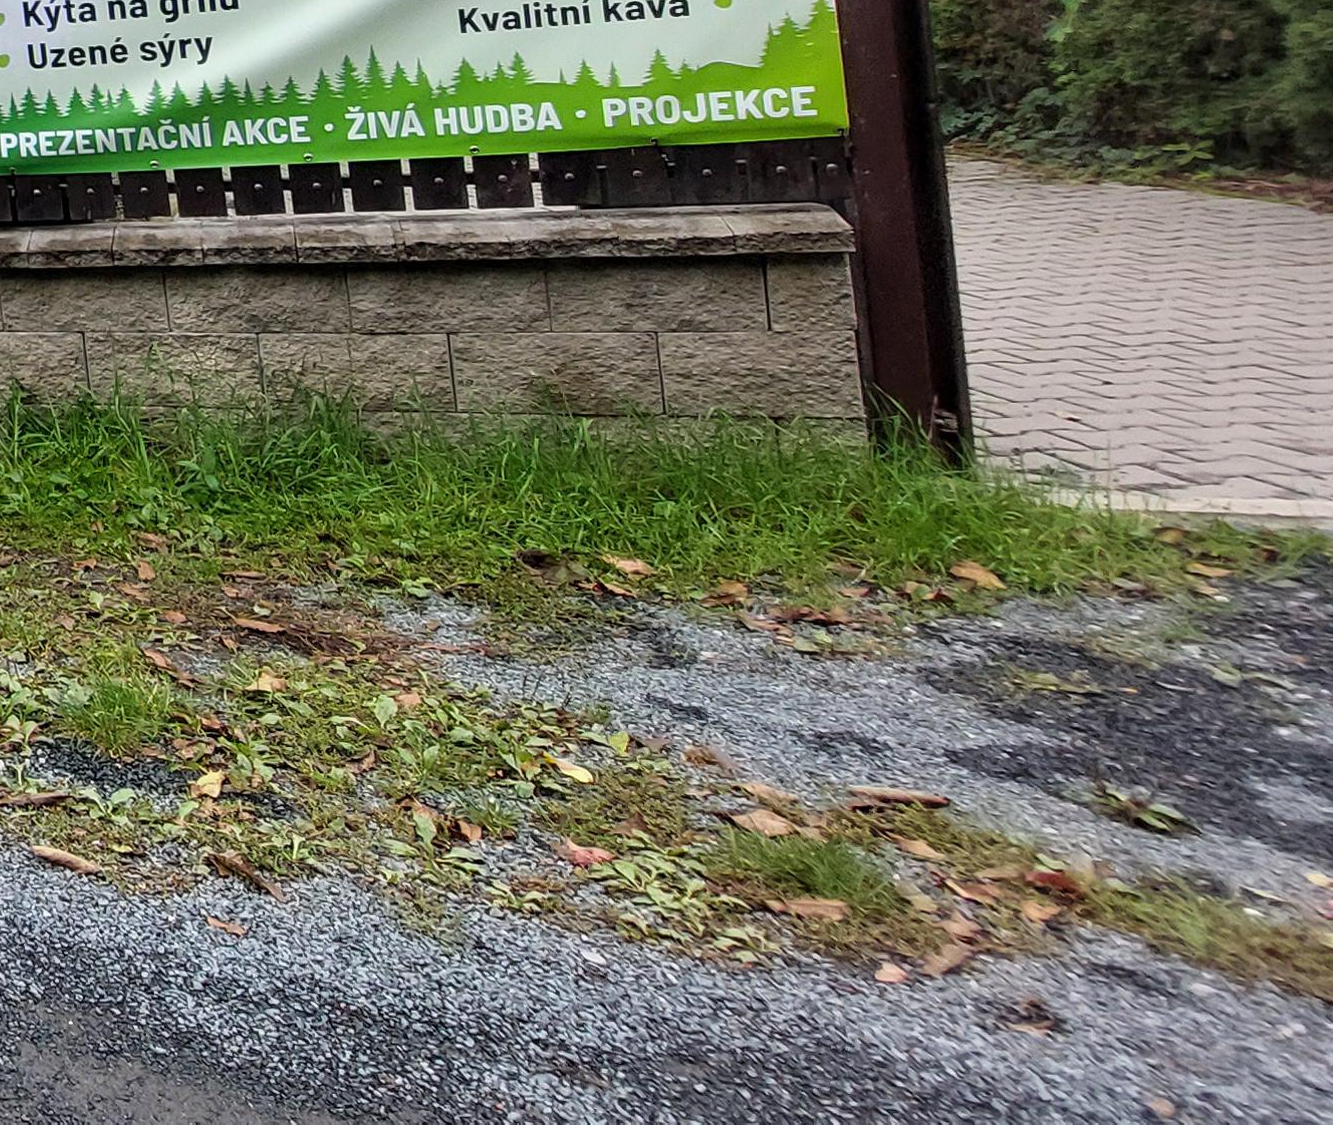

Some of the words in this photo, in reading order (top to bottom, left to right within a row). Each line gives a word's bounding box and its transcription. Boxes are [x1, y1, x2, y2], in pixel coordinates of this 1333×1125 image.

[27, 35, 128, 70] Uzené
[140, 33, 213, 67] sýry
[0, 116, 213, 159] PREZENTAČNÍ
[222, 115, 311, 147] AKCE
[345, 103, 425, 141] ŽIVÁ
[435, 101, 563, 136] HUDBA
[601, 85, 818, 127] PROJEKCE
